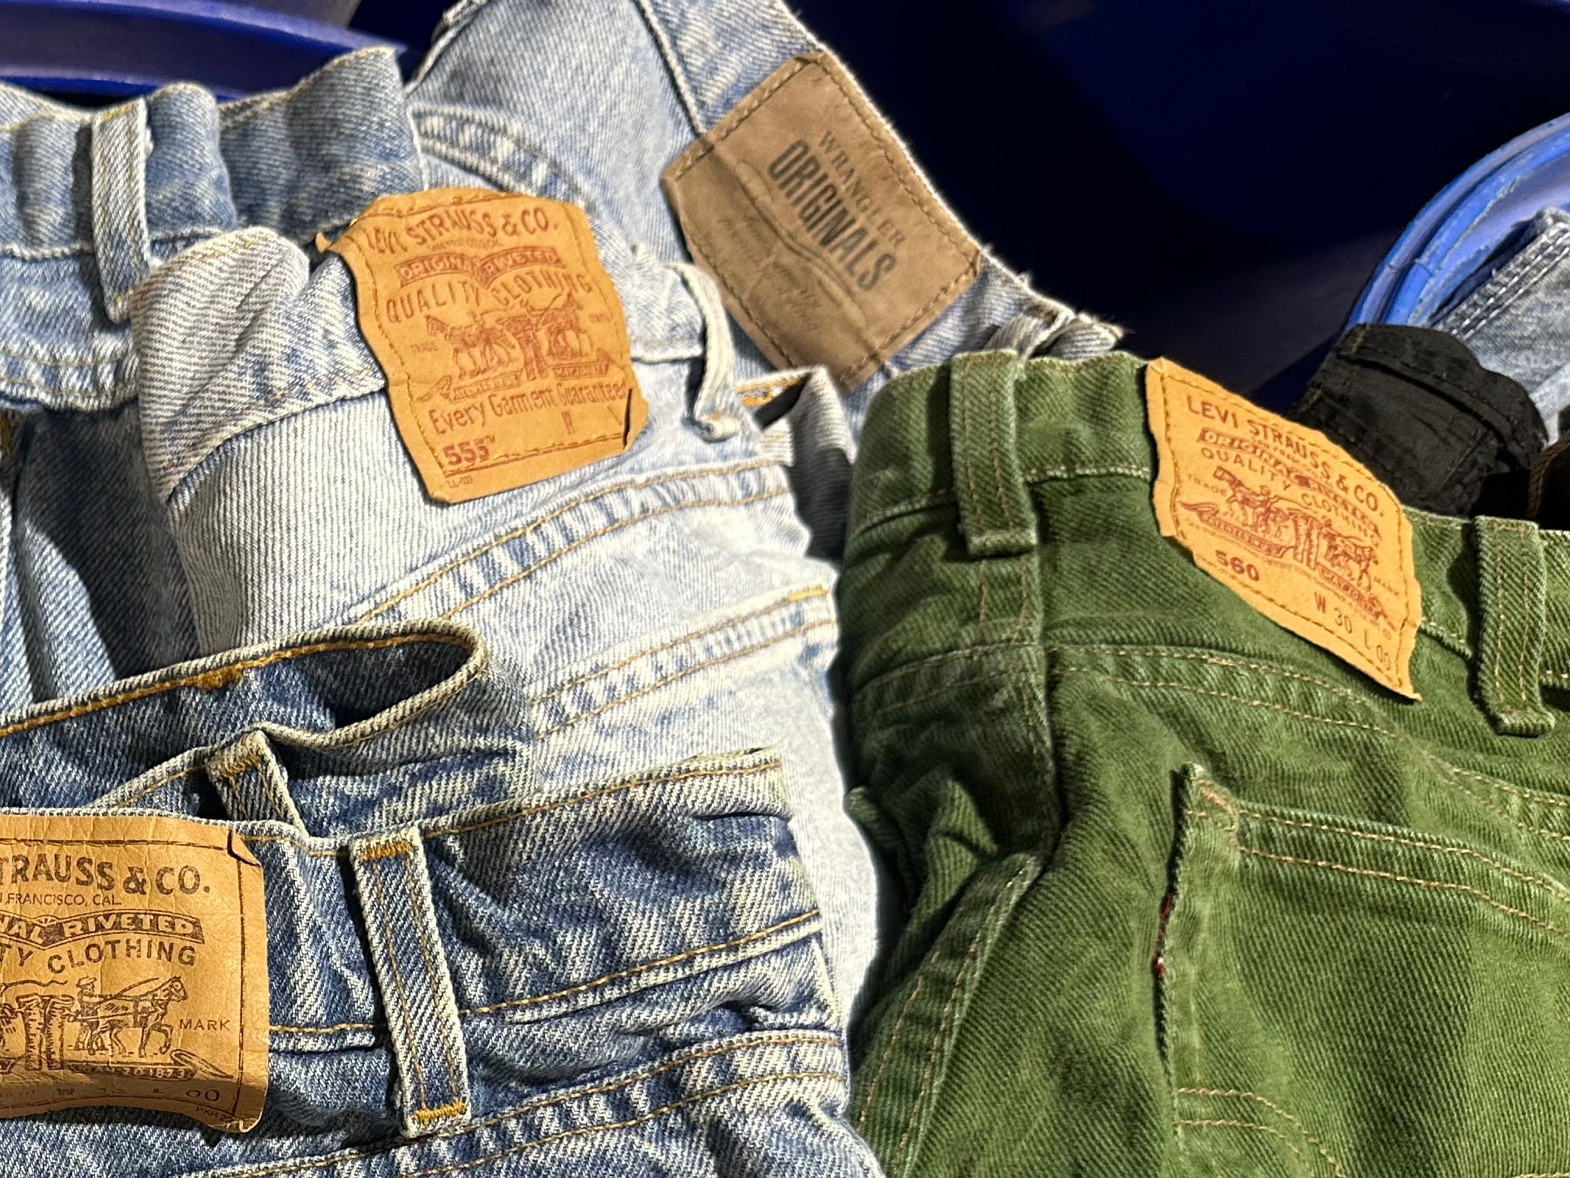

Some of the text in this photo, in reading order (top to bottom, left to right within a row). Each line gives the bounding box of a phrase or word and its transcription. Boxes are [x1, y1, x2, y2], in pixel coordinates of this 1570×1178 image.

[817, 129, 905, 246] WRANGLER
[406, 209, 497, 246] STRAUSS
[502, 213, 520, 237] &
[520, 207, 559, 235] CO.
[767, 139, 898, 292] ORIGINALS
[386, 270, 593, 323] QUALITY CLOTHING
[428, 400, 486, 435] Every
[488, 387, 554, 418] Garment
[556, 378, 628, 407] Guaranteed
[1186, 394, 1238, 429] LEVI
[1247, 419, 1330, 480] STRAUSS
[1336, 474, 1349, 495] &
[1354, 484, 1383, 517] CO.
[1201, 447, 1291, 491] QUALITY
[1215, 549, 1259, 581] 560
[1314, 591, 1326, 614] W
[1334, 607, 1352, 634] 30
[5, 892, 89, 907] FRANCISCO,
[92, 893, 122, 907] CAL.
[123, 866, 148, 895] &
[153, 864, 210, 896] CO.
[63, 914, 194, 939] RIVETED
[47, 938, 197, 974] CLOTHING
[179, 1018, 230, 1031] MARK
